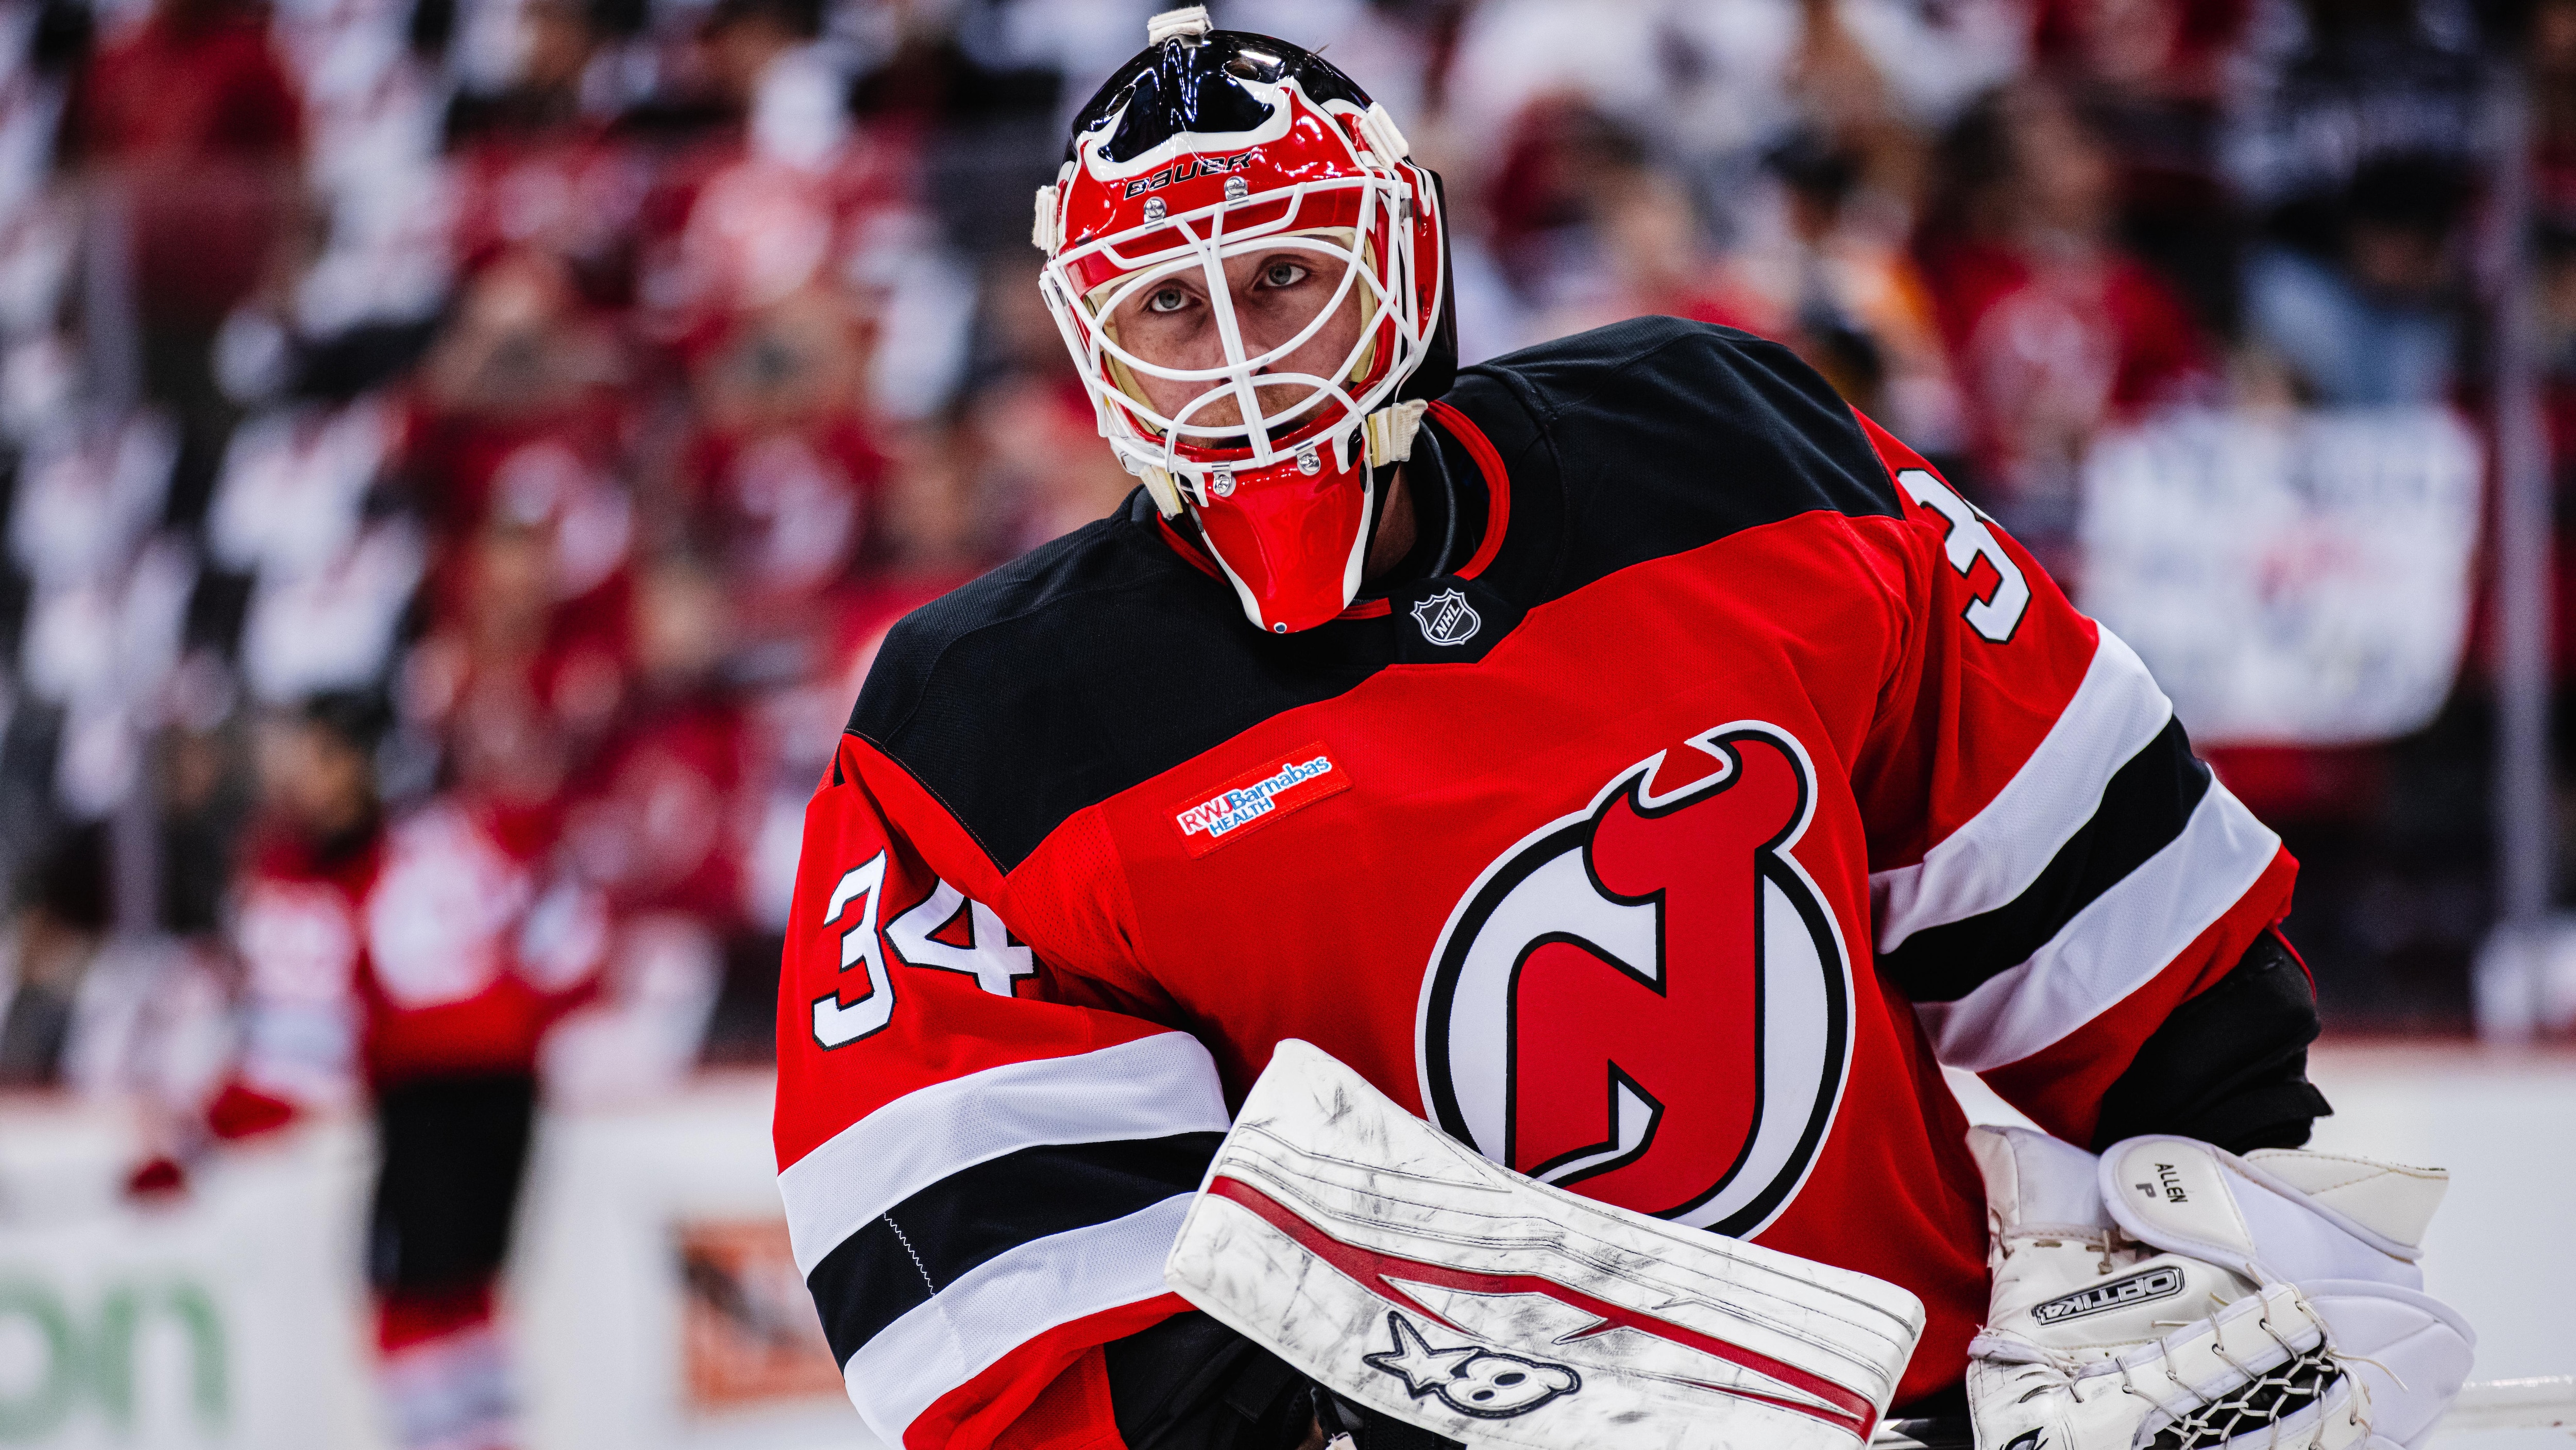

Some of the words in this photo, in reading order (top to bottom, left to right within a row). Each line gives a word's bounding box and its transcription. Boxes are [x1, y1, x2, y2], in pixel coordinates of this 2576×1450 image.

[1896, 467, 2032, 644] 3
[1435, 604, 1460, 638] NHL
[1180, 756, 1330, 833] RWJBarnabas
[1209, 797, 1273, 835] HEALTH
[811, 845, 1039, 1052] 34
[2135, 1183, 2157, 1199] P
[2155, 1163, 2189, 1203] ALLEN
